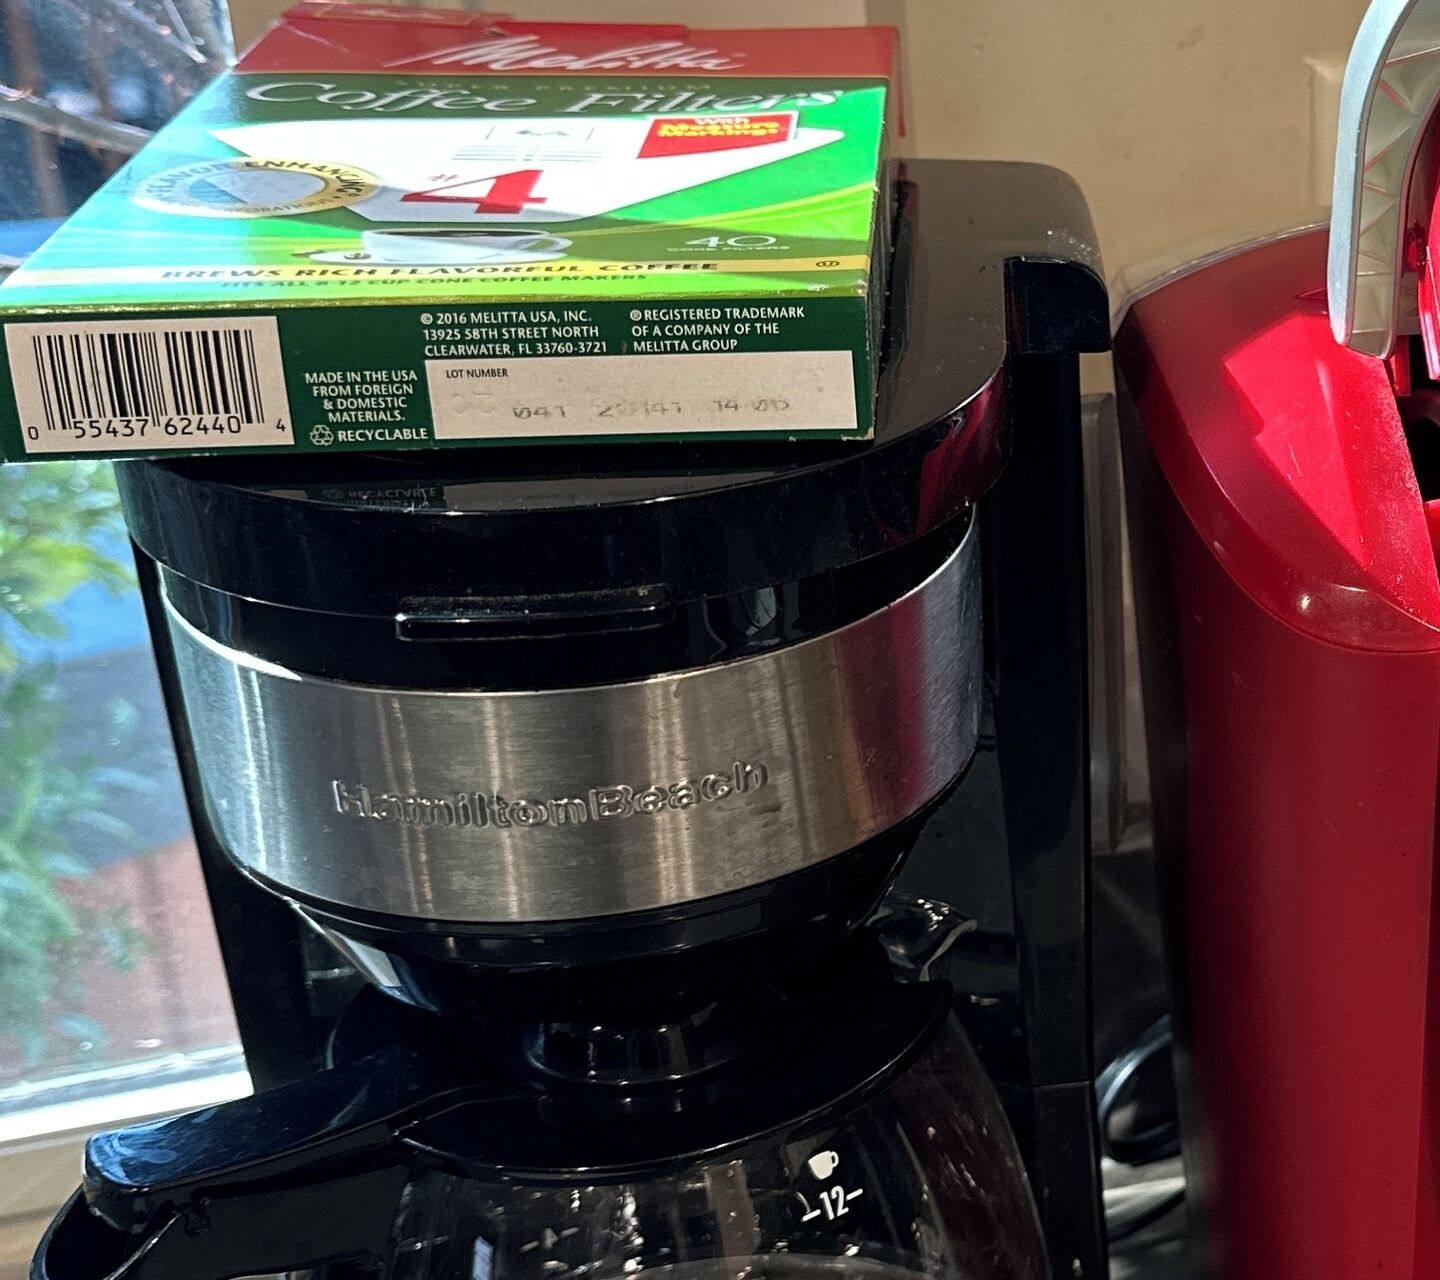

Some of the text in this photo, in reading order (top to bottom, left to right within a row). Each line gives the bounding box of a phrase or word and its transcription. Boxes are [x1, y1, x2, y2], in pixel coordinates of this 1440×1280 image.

[382, 35, 745, 70] Melitta
[536, 83, 711, 91] PREMIUM
[245, 81, 845, 113] Coffee Filters
[243, 160, 365, 194] ENHANCING
[685, 234, 777, 248] 40
[161, 263, 719, 279] BREWS RICH FLAVORFUL COFFEE
[416, 277, 474, 285] CONE
[436, 312, 467, 325] 2016
[470, 311, 528, 324] MELITTA
[530, 311, 561, 324] USA,
[563, 310, 593, 323] INC.
[724, 306, 805, 320] TRADEMARK
[423, 325, 599, 341] 13925 58TH STREET NORTH
[631, 322, 780, 337] OF A COMPANY OF THE
[424, 341, 607, 357] CLEARWATER, FL 33760-3721
[633, 338, 738, 353] MELITTA GROUP
[305, 369, 418, 384] MADE IN THE USA
[445, 367, 509, 380] LOT NUMBER
[312, 383, 414, 397] FROM FOREIGN
[323, 396, 408, 410] & DOMESTIC
[328, 409, 406, 423] MATERIALS.
[28, 414, 287, 441] 0 55437 62440 4
[337, 427, 429, 442] RECYCLABLE
[819, 1185, 850, 1221] 12
